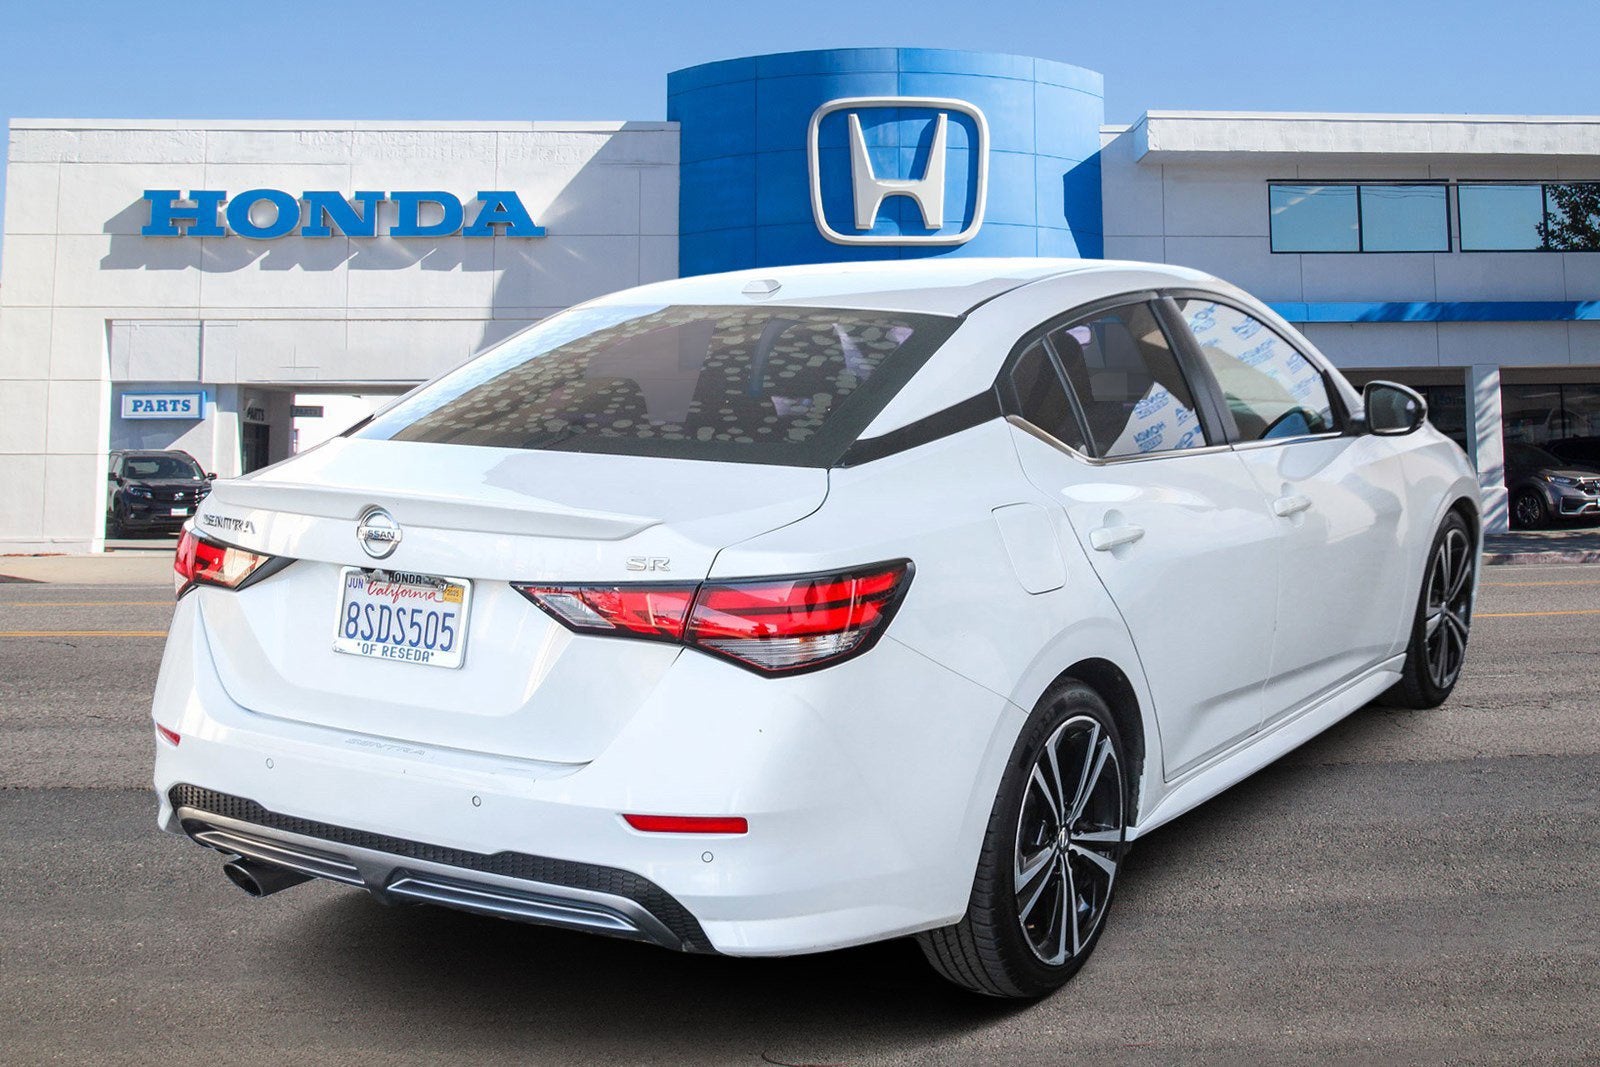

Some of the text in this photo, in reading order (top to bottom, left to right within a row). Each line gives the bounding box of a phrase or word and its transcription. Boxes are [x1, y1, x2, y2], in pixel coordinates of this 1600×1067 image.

[141, 188, 547, 240] HONDA
[131, 399, 191, 413] PARTS
[625, 556, 671, 571] SR
[347, 577, 364, 589] JUN
[388, 572, 422, 584] HONDA
[367, 581, 444, 604] California
[345, 601, 455, 652] 8SDS505
[381, 645, 431, 662] RESEDA
